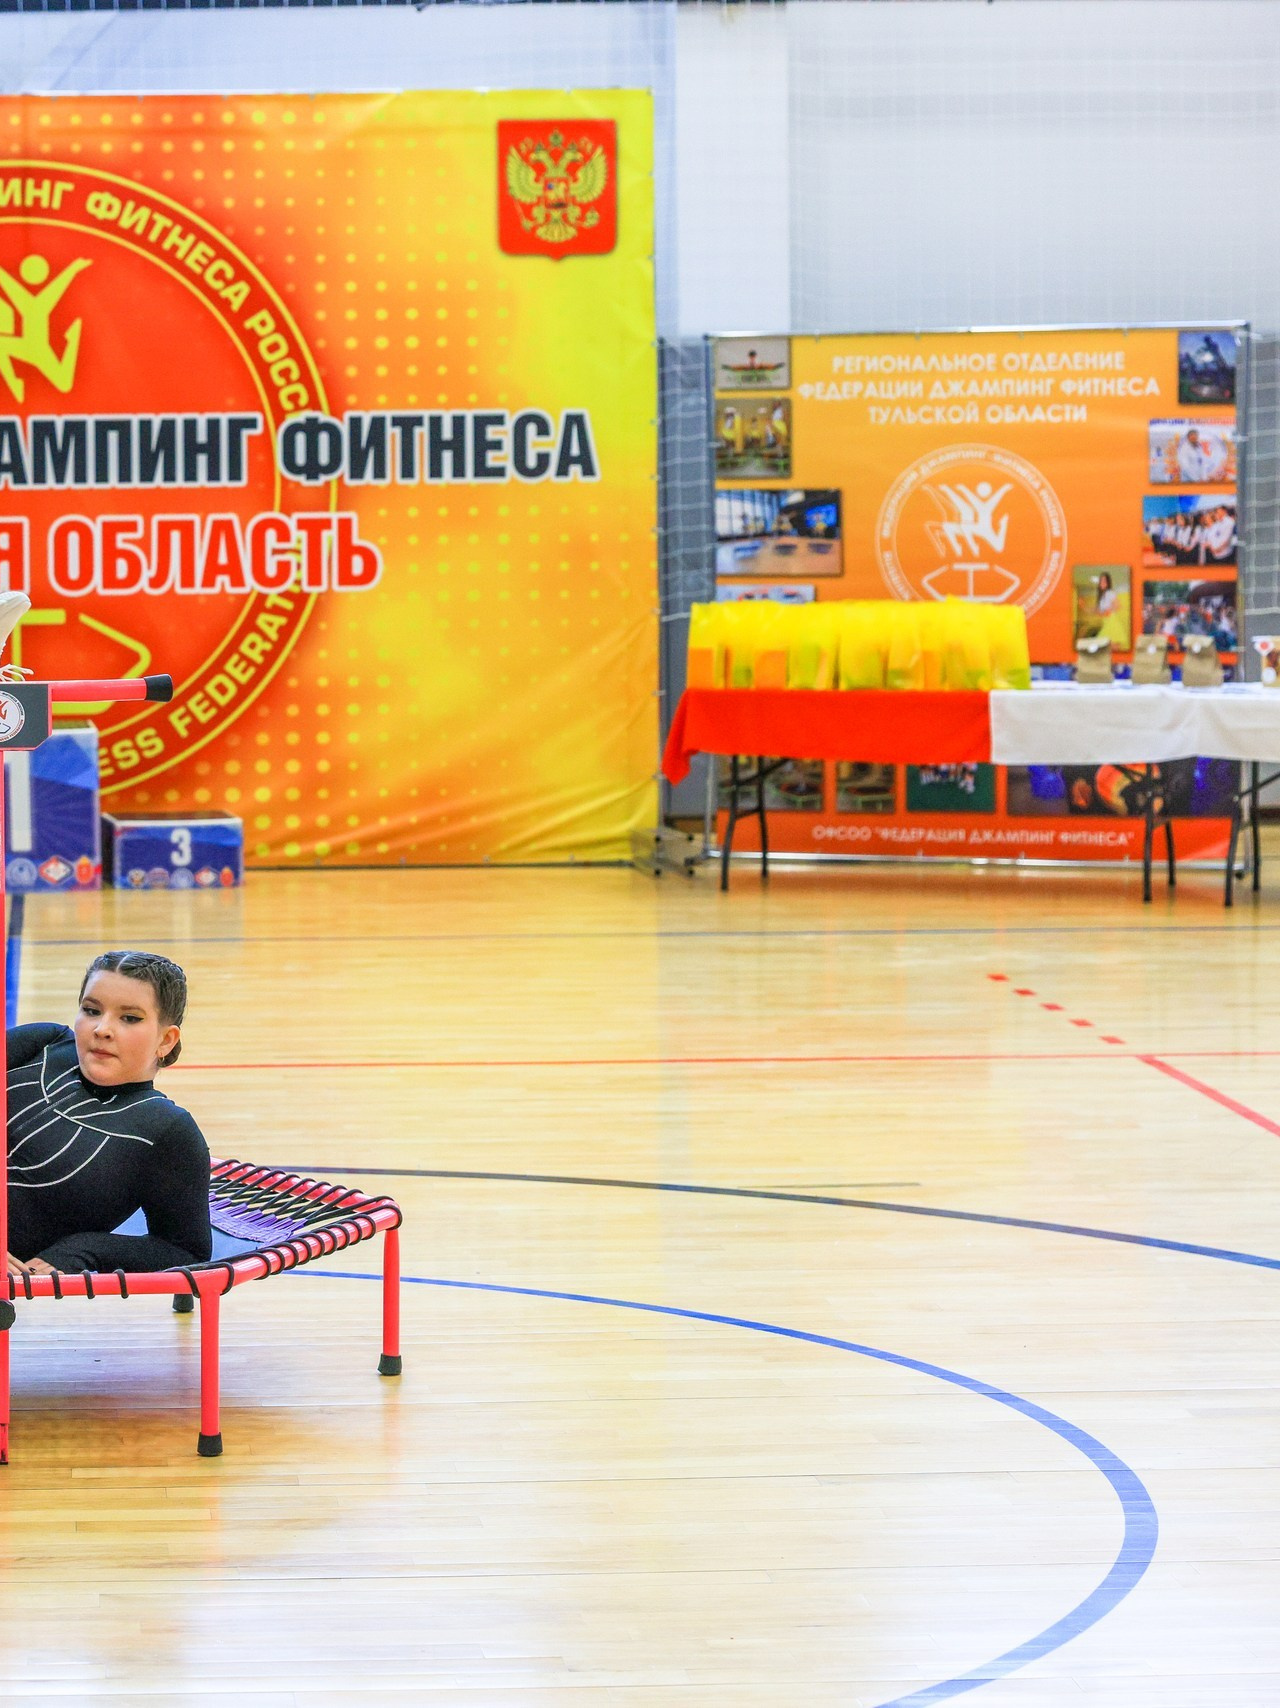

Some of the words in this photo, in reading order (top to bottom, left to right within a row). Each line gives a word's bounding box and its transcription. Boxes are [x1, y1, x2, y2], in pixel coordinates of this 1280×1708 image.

[85, 182, 252, 313] ФИТНЕСА
[243, 308, 312, 420] РОСС
[832, 353, 997, 374] РЕГИОНАЛЬНОЕ
[1002, 351, 1125, 373] ОТДЕЛЕНИЕ
[798, 381, 923, 401] ФЕДЕРАЦИИ
[928, 379, 1056, 400] ДЖАМПИНГ
[1060, 377, 1161, 397] ФИТНЕСА
[867, 404, 979, 425] ТУЛЬСКОЙ
[985, 403, 1087, 424] ОБЛАСТИ
[277, 407, 599, 485] ФИТНЕСА
[47, 510, 384, 596] ОБЛАСТЬ
[168, 584, 302, 738] FEDERAT
[169, 828, 192, 868] 3
[969, 828, 1056, 845] ДЖАМПИНГ
